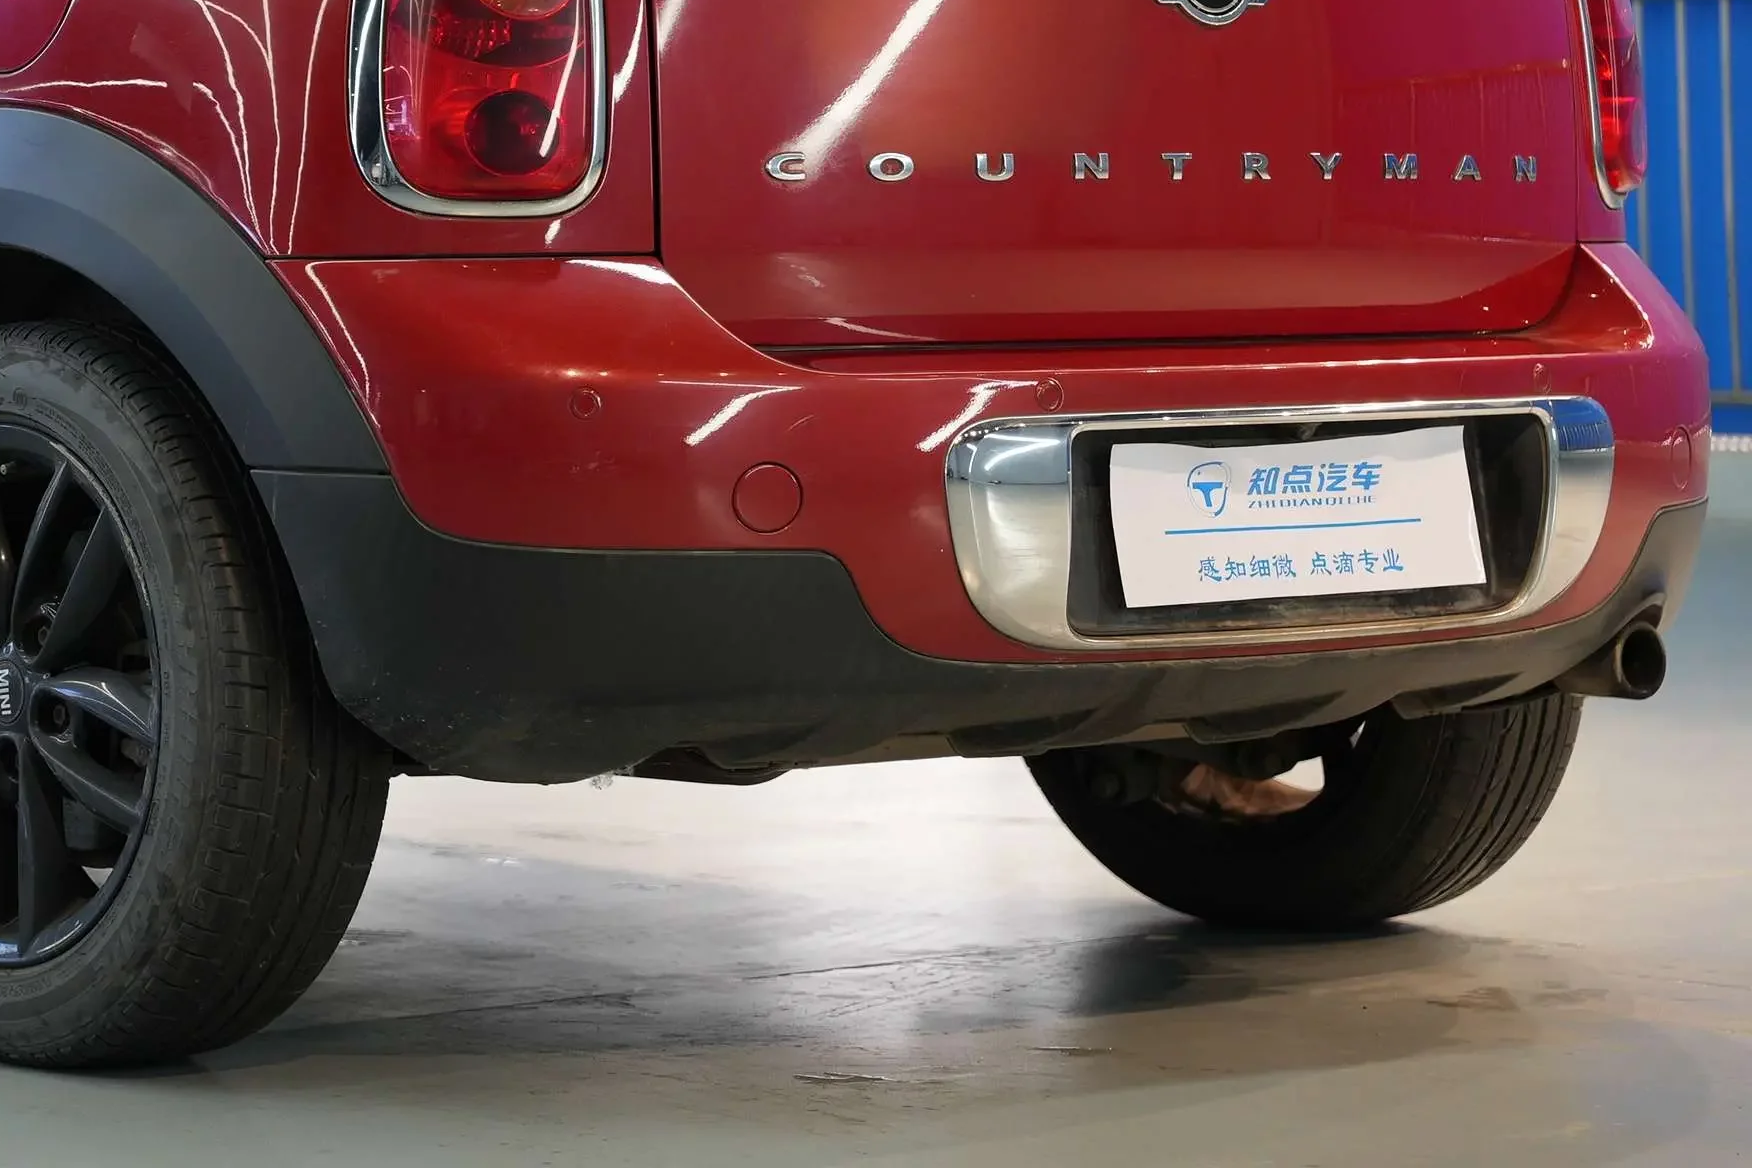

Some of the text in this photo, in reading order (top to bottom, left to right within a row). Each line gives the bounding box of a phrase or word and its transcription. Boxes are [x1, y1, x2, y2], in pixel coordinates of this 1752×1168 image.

[765, 151, 1538, 183] COUNTRYMAN
[1247, 461, 1383, 496] 知点汽车
[1198, 547, 1405, 583] 感知细微 点滴专业
